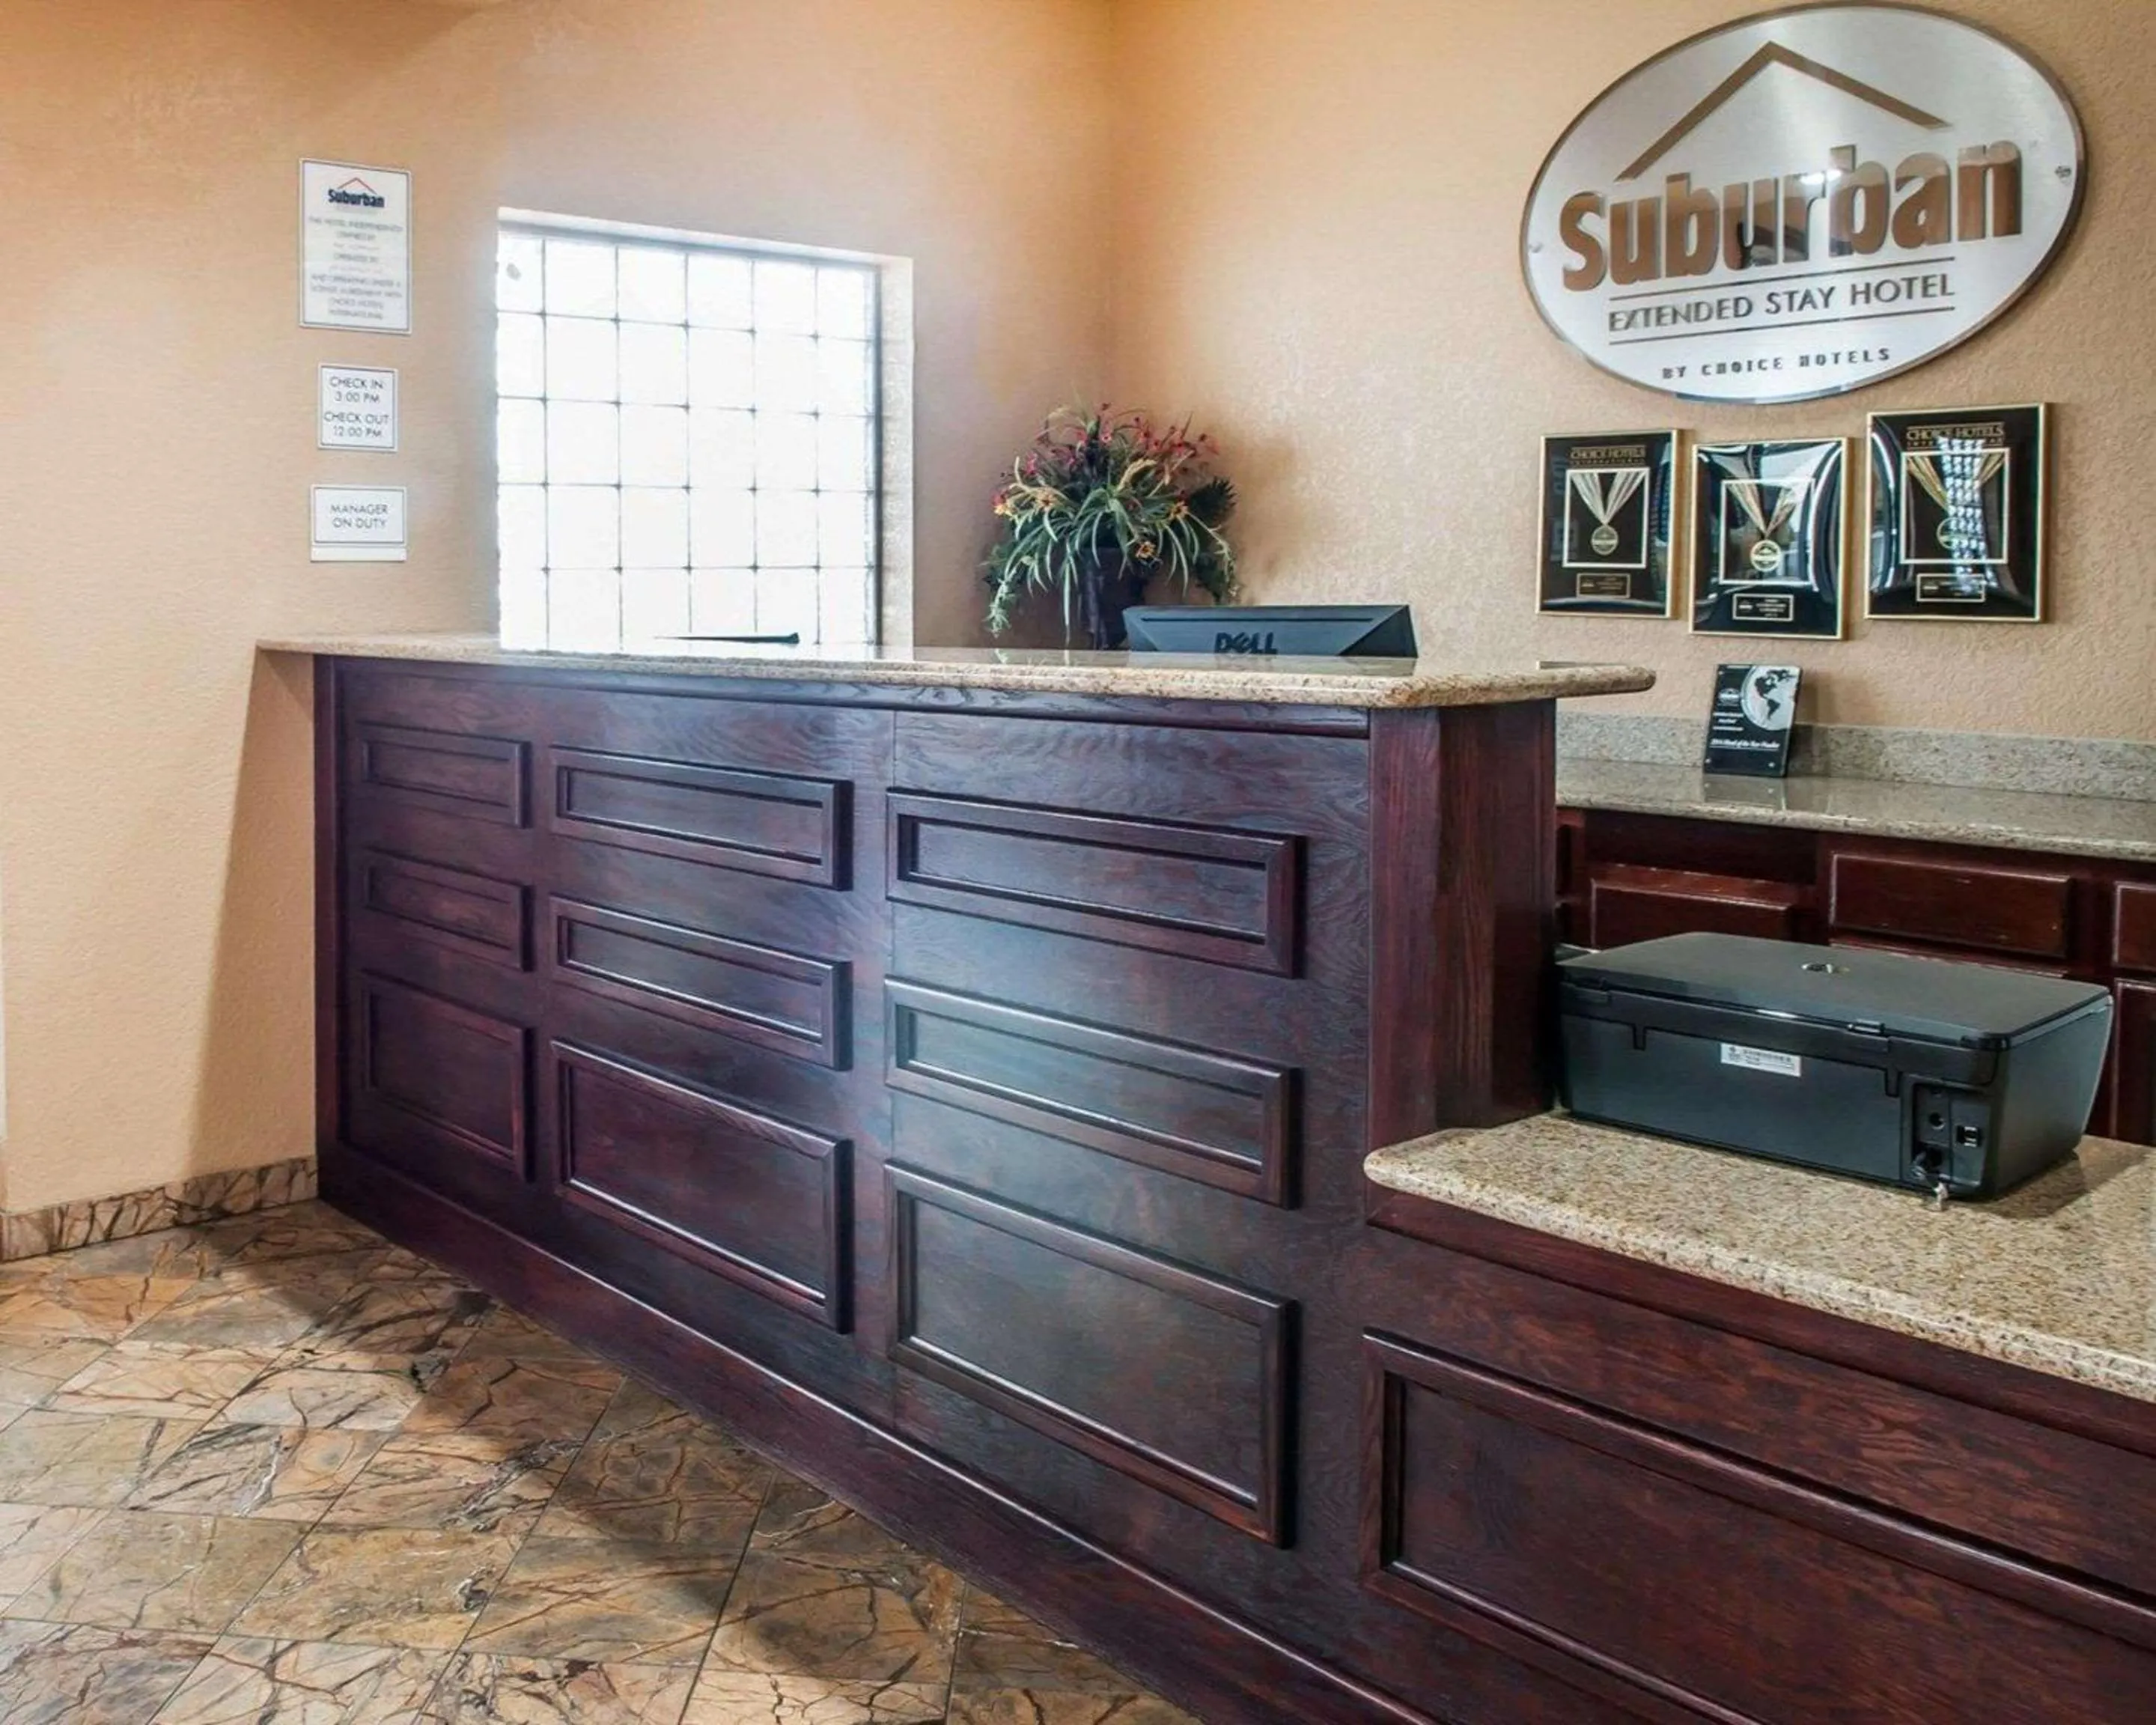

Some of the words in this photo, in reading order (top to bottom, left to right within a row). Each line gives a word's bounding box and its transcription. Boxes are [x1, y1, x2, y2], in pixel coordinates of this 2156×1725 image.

[328, 189, 385, 208] Suburban
[1560, 140, 2023, 292] Suburban
[1608, 296, 1753, 332] EXTENDED
[1764, 286, 1836, 314] STAY
[1851, 273, 1955, 305] HOTEL
[1662, 365, 1687, 380] BY
[1701, 356, 1784, 376] CHOICE
[1799, 347, 1891, 368] HOTELS
[330, 377, 368, 389] CHECK
[371, 379, 384, 389] IN
[363, 392, 380, 403] PM
[323, 410, 362, 423] CHECK
[365, 413, 389, 425] OUT
[365, 427, 382, 437] PM
[331, 504, 389, 515] MANAGER
[332, 517, 352, 528] ON
[356, 517, 387, 529] DUTY
[1214, 631, 1279, 654] DELL
